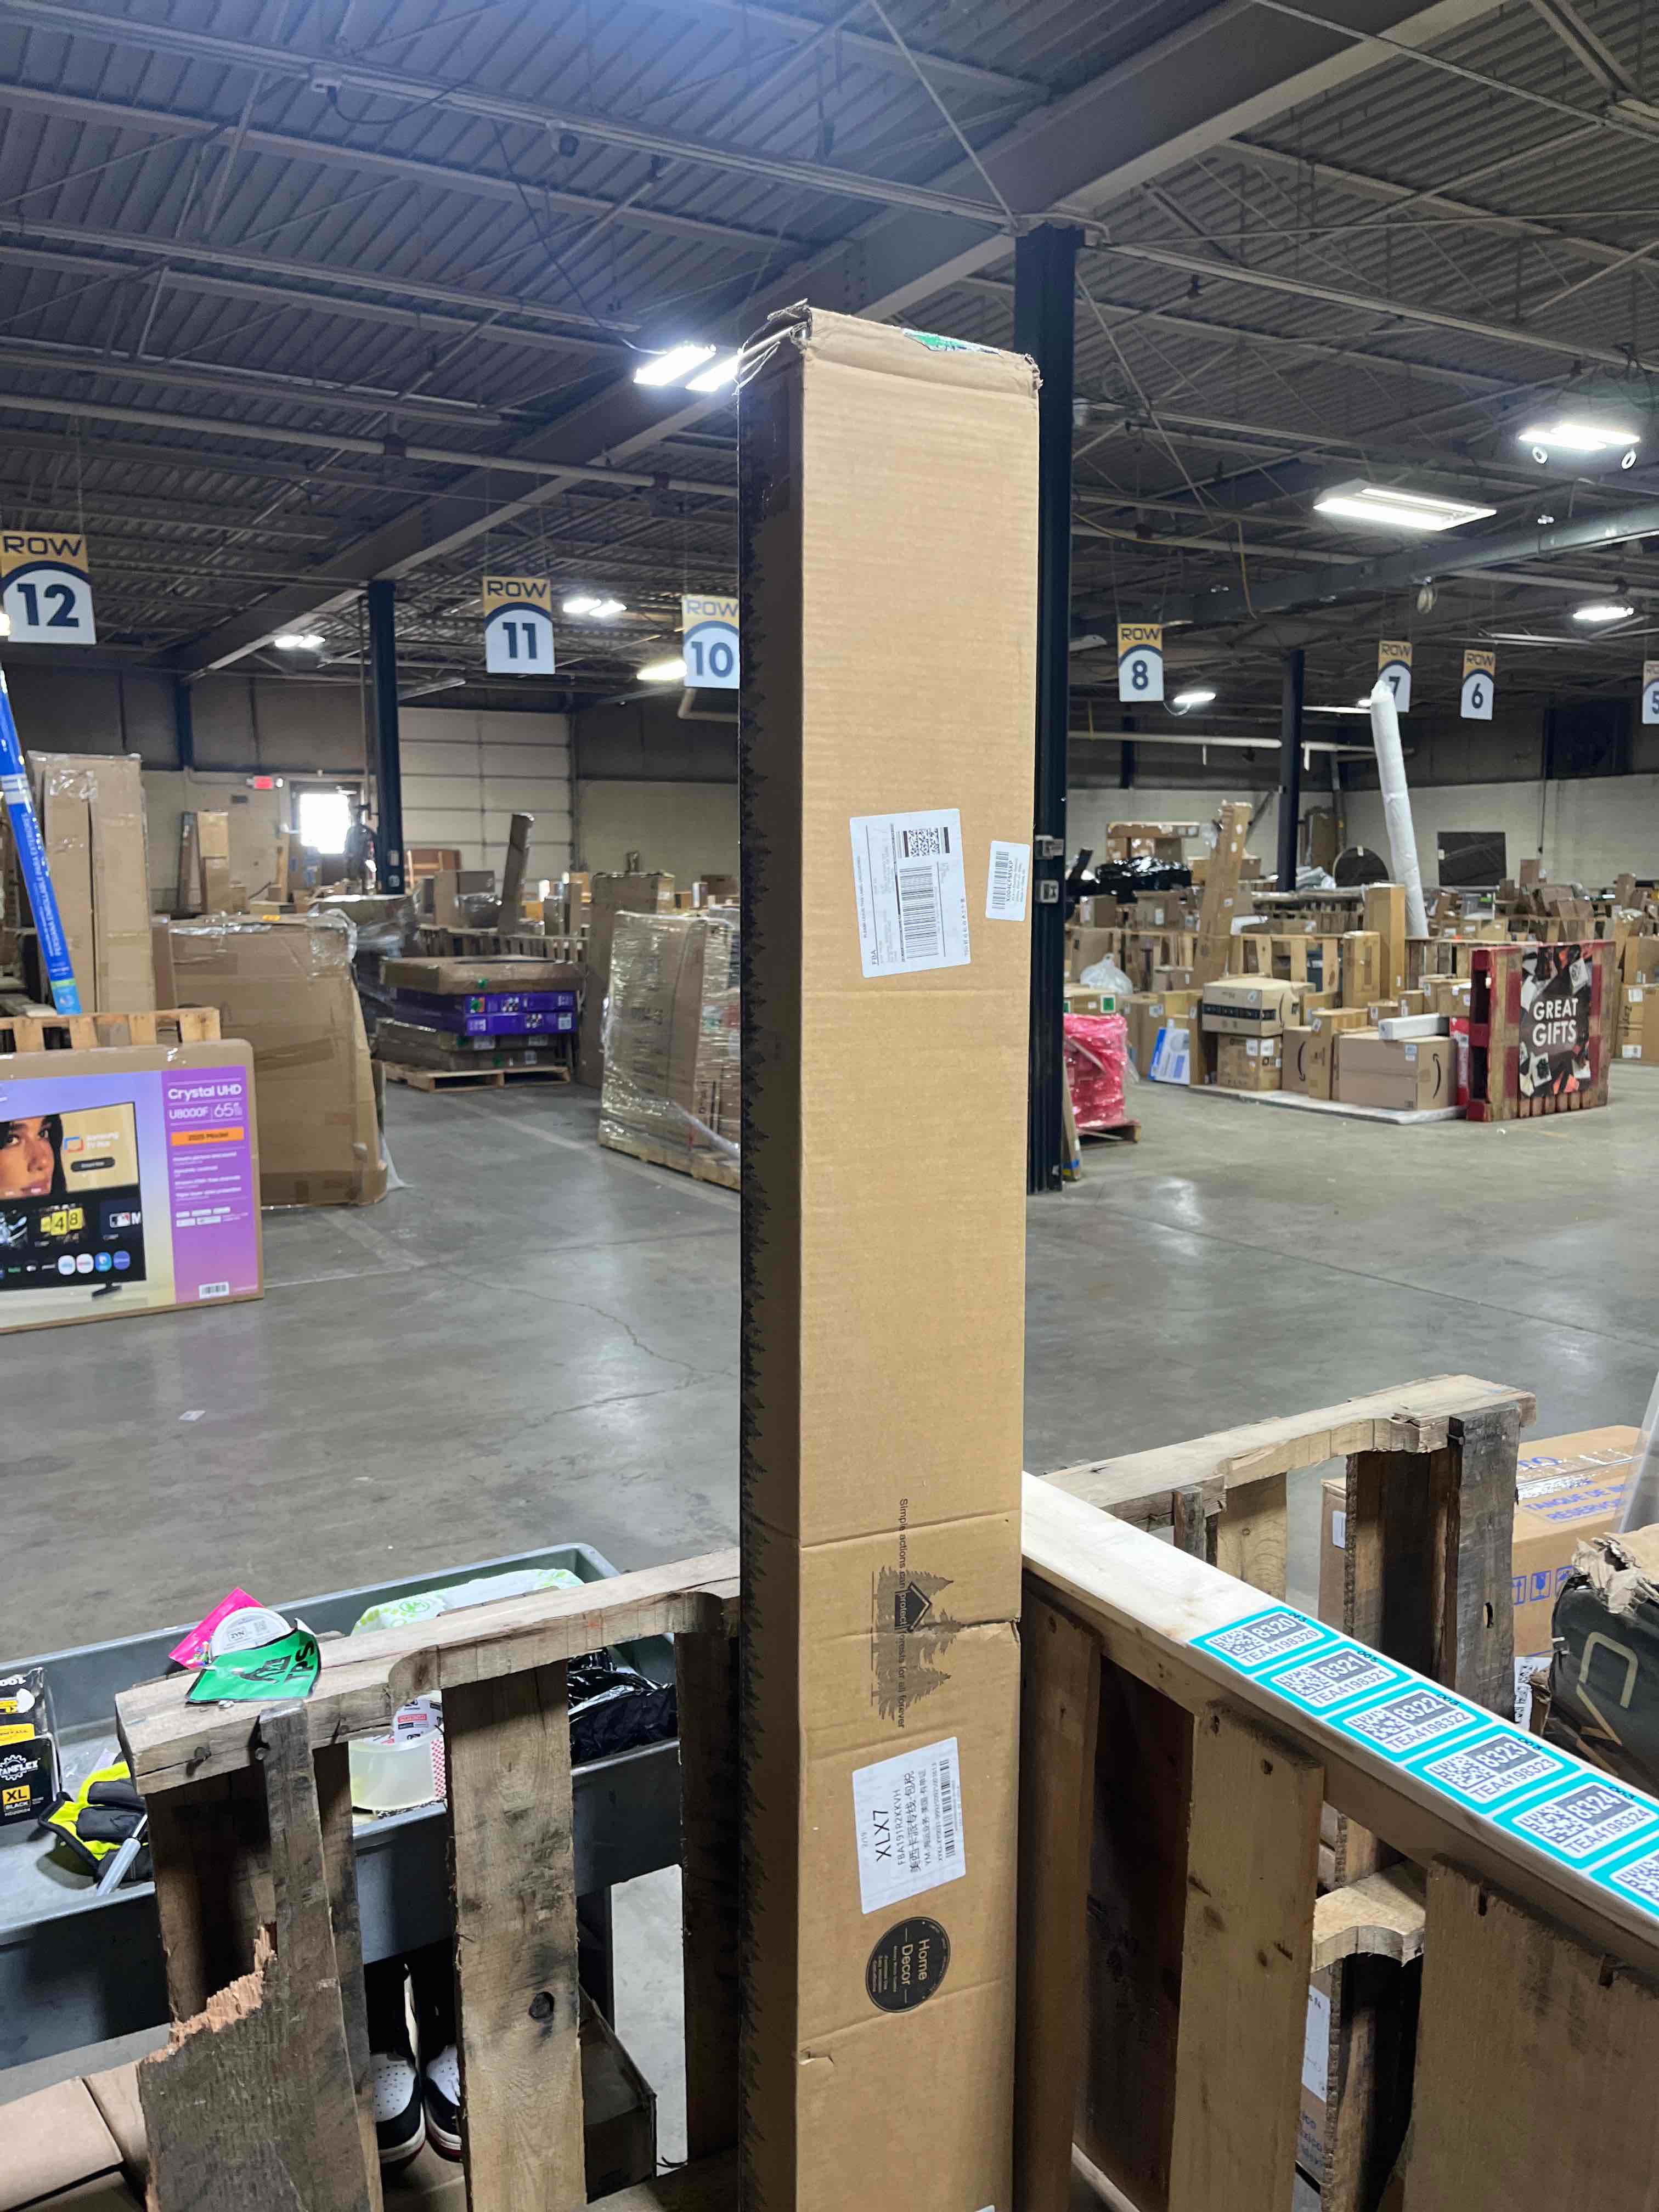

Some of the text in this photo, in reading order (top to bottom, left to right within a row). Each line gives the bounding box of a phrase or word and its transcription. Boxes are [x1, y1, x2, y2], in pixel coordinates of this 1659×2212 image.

[3, 535, 82, 556] ROW
[487, 580, 546, 598] ROW
[17, 583, 80, 628] 12
[686, 600, 739, 616] ROW
[503, 622, 538, 659] 11
[1121, 628, 1159, 641] ROW
[691, 641, 733, 678] 10
[1382, 644, 1411, 657] ROW
[1466, 653, 1493, 667] ROW
[1132, 661, 1148, 690] 8
[1389, 676, 1401, 697] 7
[1472, 683, 1483, 709] 6
[1533, 998, 1578, 1021] GREAT
[1532, 1020, 1577, 1047] GIFTS
[168, 1084, 242, 1102] Crystal UHD
[214, 1103, 234, 1118] 65
[898, 1498, 909, 1531] Simple
[899, 1534, 907, 1568] actions
[898, 1593, 908, 1626] protect
[230, 1630, 245, 1639] ZYN
[1251, 1617, 1297, 1639] 8320
[898, 1630, 906, 1664] forests
[1240, 1630, 1319, 1663] TEA4198320
[1318, 1654, 1367, 1679] 8321
[1309, 1669, 1390, 1705] TEA4198321
[896, 1693, 905, 1729] forever
[1393, 1697, 1445, 1722] 8322
[1385, 1712, 1471, 1750] TEA4198322
[0, 1760, 38, 1775] TANFLEX
[1476, 1742, 1528, 1768] 8323
[1470, 1758, 1556, 1799] TEA4198323
[5, 1801, 28, 1809] BLACK
[6, 1789, 27, 1802] XL
[1567, 1791, 1622, 1820] 8324
[872, 1809, 893, 1863] XLX7
[1563, 1808, 1651, 1853] TEA4198324
[901, 1944, 913, 1985] Decor
[918, 1939, 930, 1981] Home
